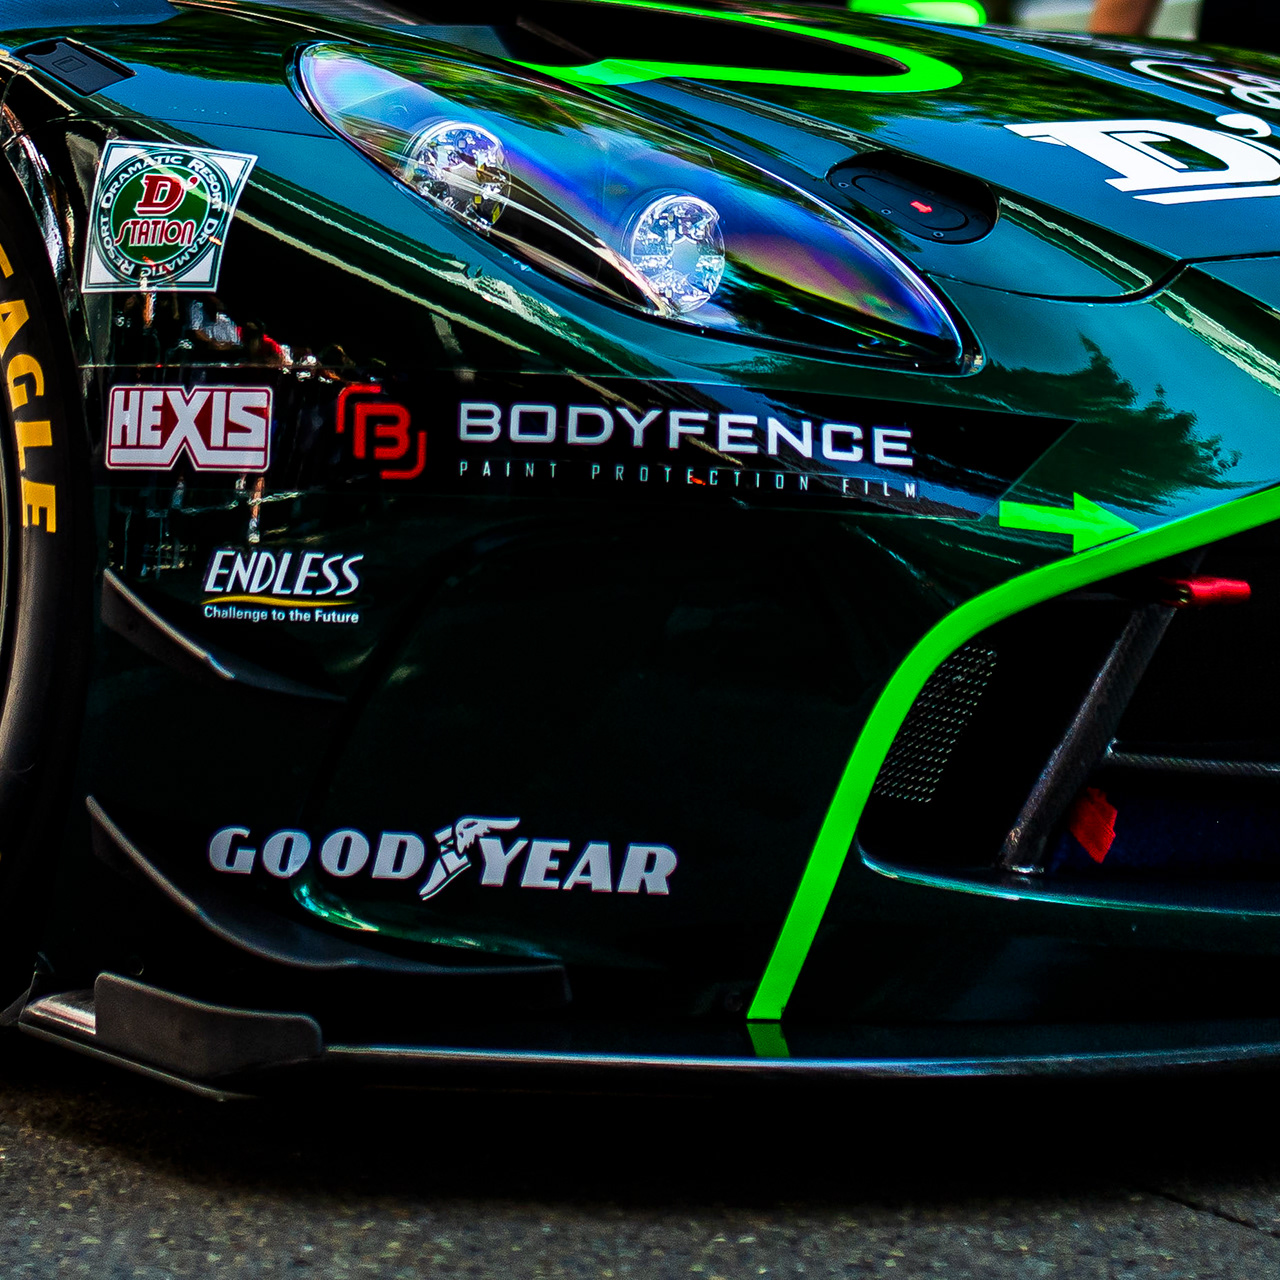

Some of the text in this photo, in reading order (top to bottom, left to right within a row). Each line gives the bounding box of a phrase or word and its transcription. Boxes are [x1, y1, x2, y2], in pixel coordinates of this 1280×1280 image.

[100, 155, 221, 277] DRAMATIC RESORT DRAMATIC RESORT
[114, 218, 197, 247] STATION
[109, 390, 269, 466] HEXIS
[459, 402, 914, 467] BODYFENCE
[459, 460, 918, 499] PAINT PROTECTION FILM
[204, 549, 365, 597] ENDLESS
[203, 604, 360, 624] Challenge to the Future
